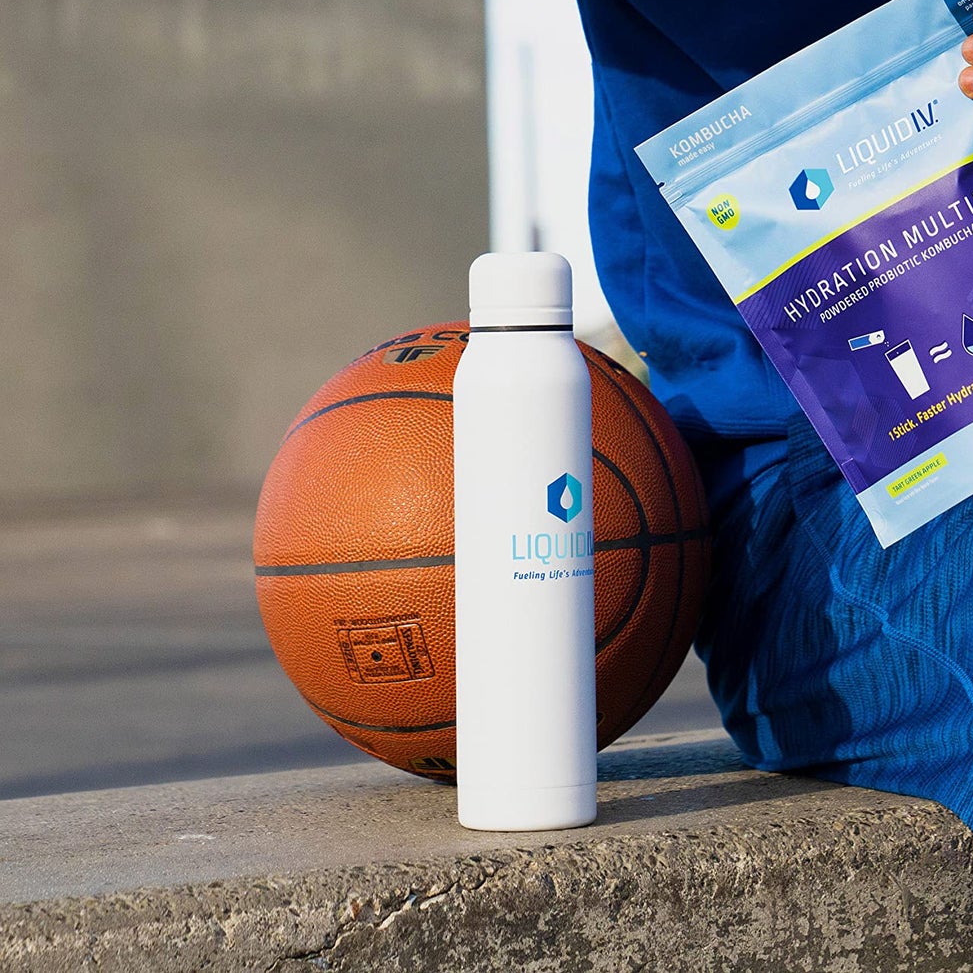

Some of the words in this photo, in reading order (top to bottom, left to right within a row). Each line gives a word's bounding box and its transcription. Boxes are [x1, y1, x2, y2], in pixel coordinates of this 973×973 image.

[669, 105, 753, 158] KOMBUCHA
[836, 117, 914, 174] LIQUID
[677, 152, 699, 167] made
[698, 141, 716, 155] easy
[848, 169, 877, 188] Fueling
[877, 158, 899, 174] Life's
[900, 133, 943, 160] Adventures
[711, 199, 731, 216] NON
[716, 208, 735, 225] GMO
[783, 239, 898, 323] HYDRATION
[819, 285, 870, 323] POWDERED
[868, 254, 921, 292] PROBIOTIC
[893, 418, 919, 440] Stick.
[916, 400, 947, 424] Faster
[892, 481, 905, 492] TART
[904, 470, 923, 485] GREEN
[922, 458, 942, 474] APPLE
[512, 532, 586, 565] LIQUID
[513, 571, 546, 581] Fueling
[549, 569, 570, 580] Life's
[402, 628, 425, 674] SPALDING
